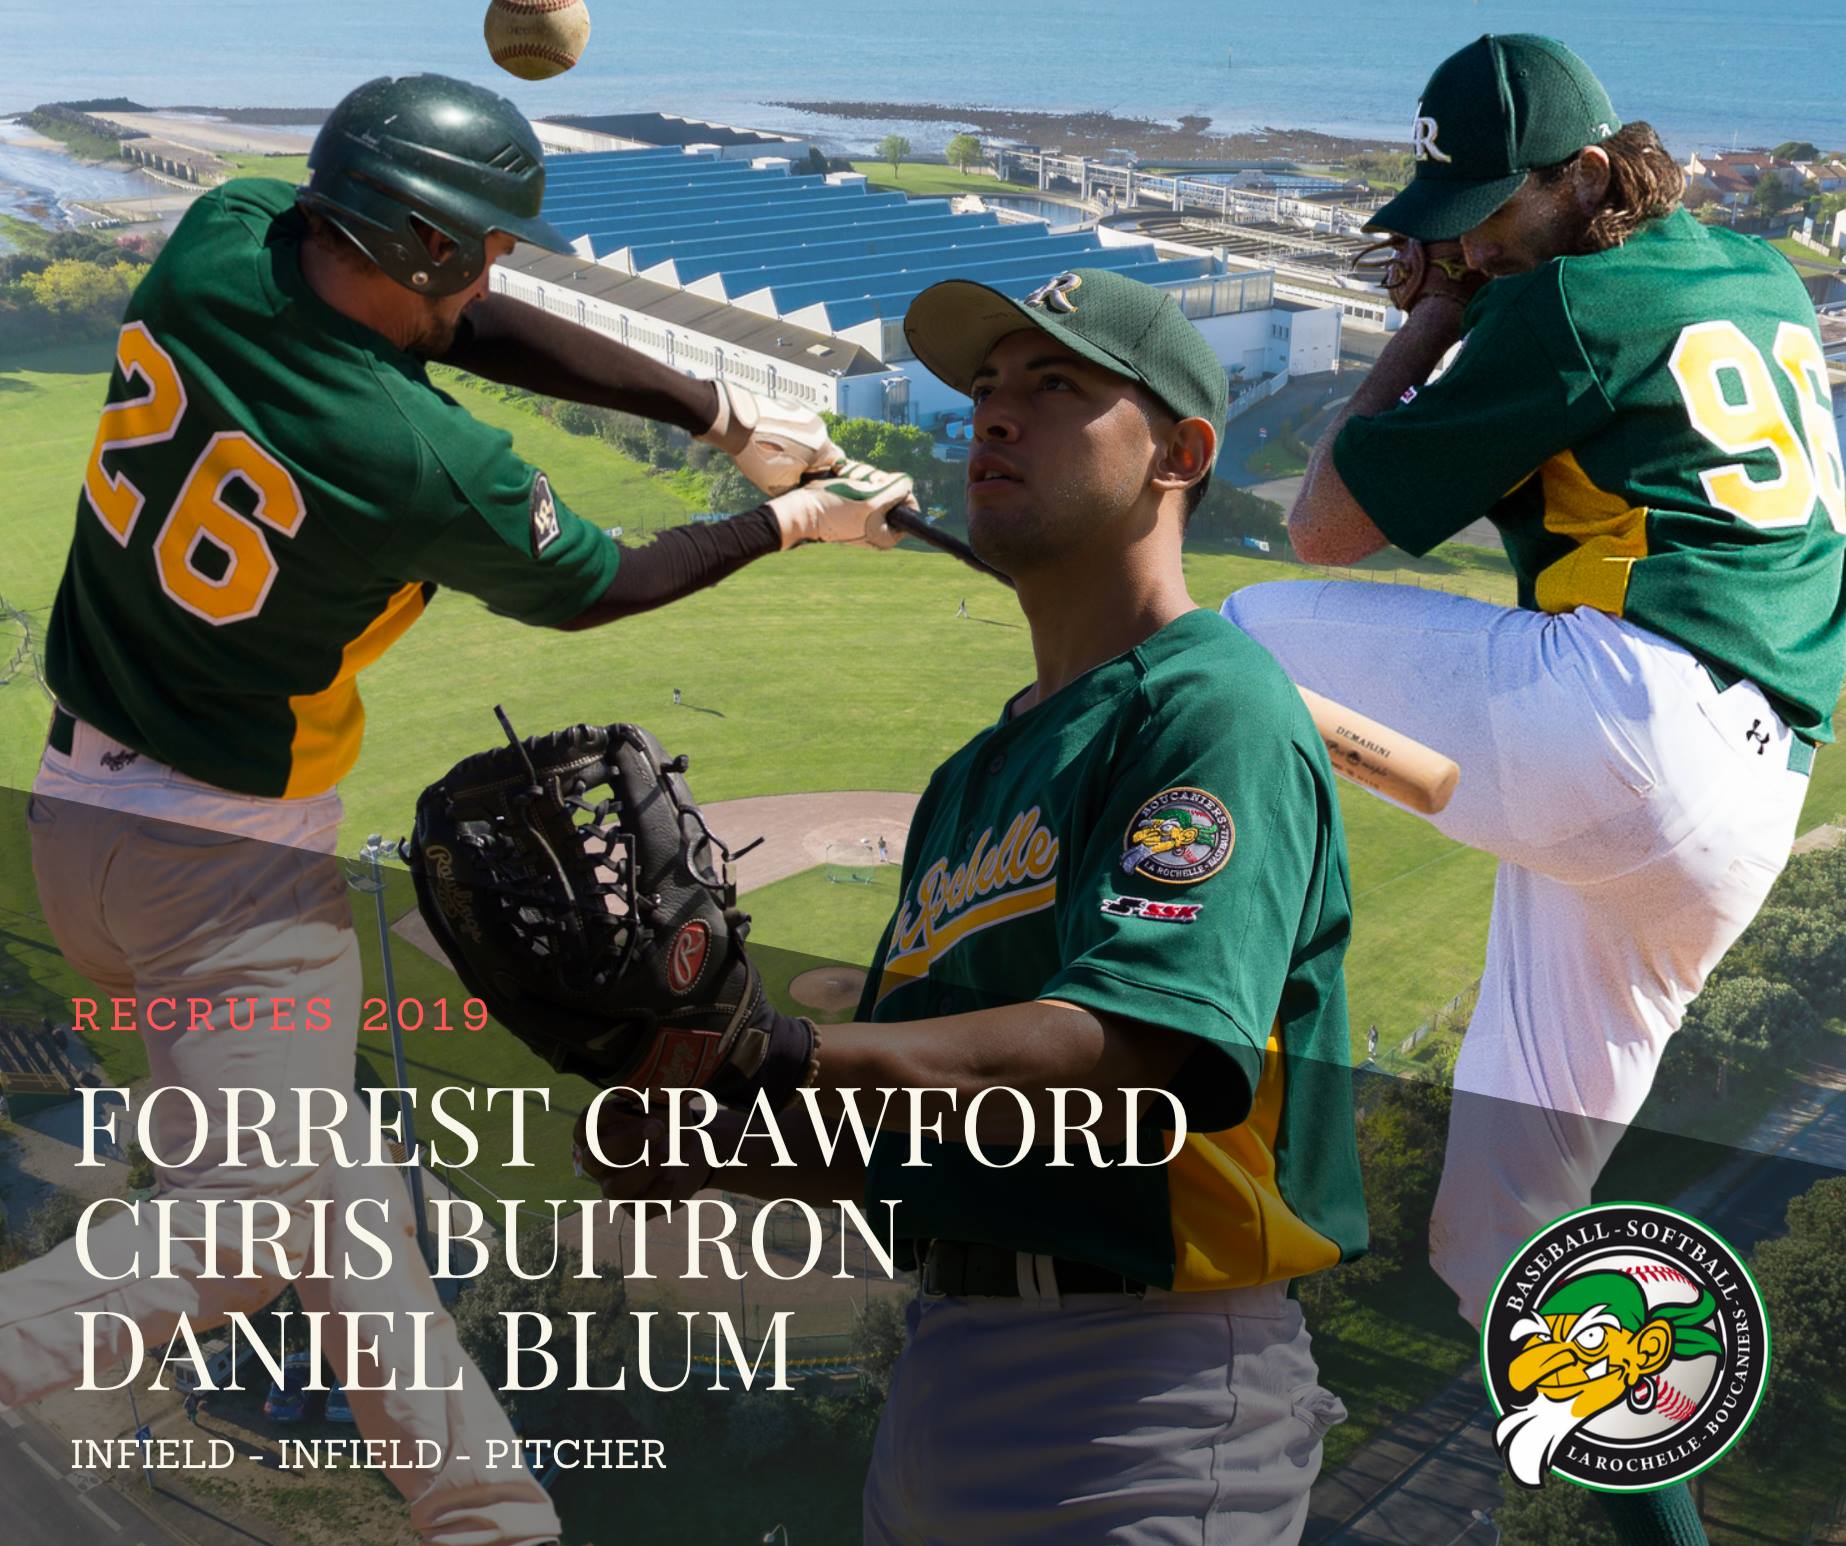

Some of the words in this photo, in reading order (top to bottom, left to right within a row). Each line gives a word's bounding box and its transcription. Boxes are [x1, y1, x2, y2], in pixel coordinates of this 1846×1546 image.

[84, 320, 308, 626] 26
[1336, 726, 1391, 758] DEMARINI
[1142, 791, 1227, 824] BOUCANIERS
